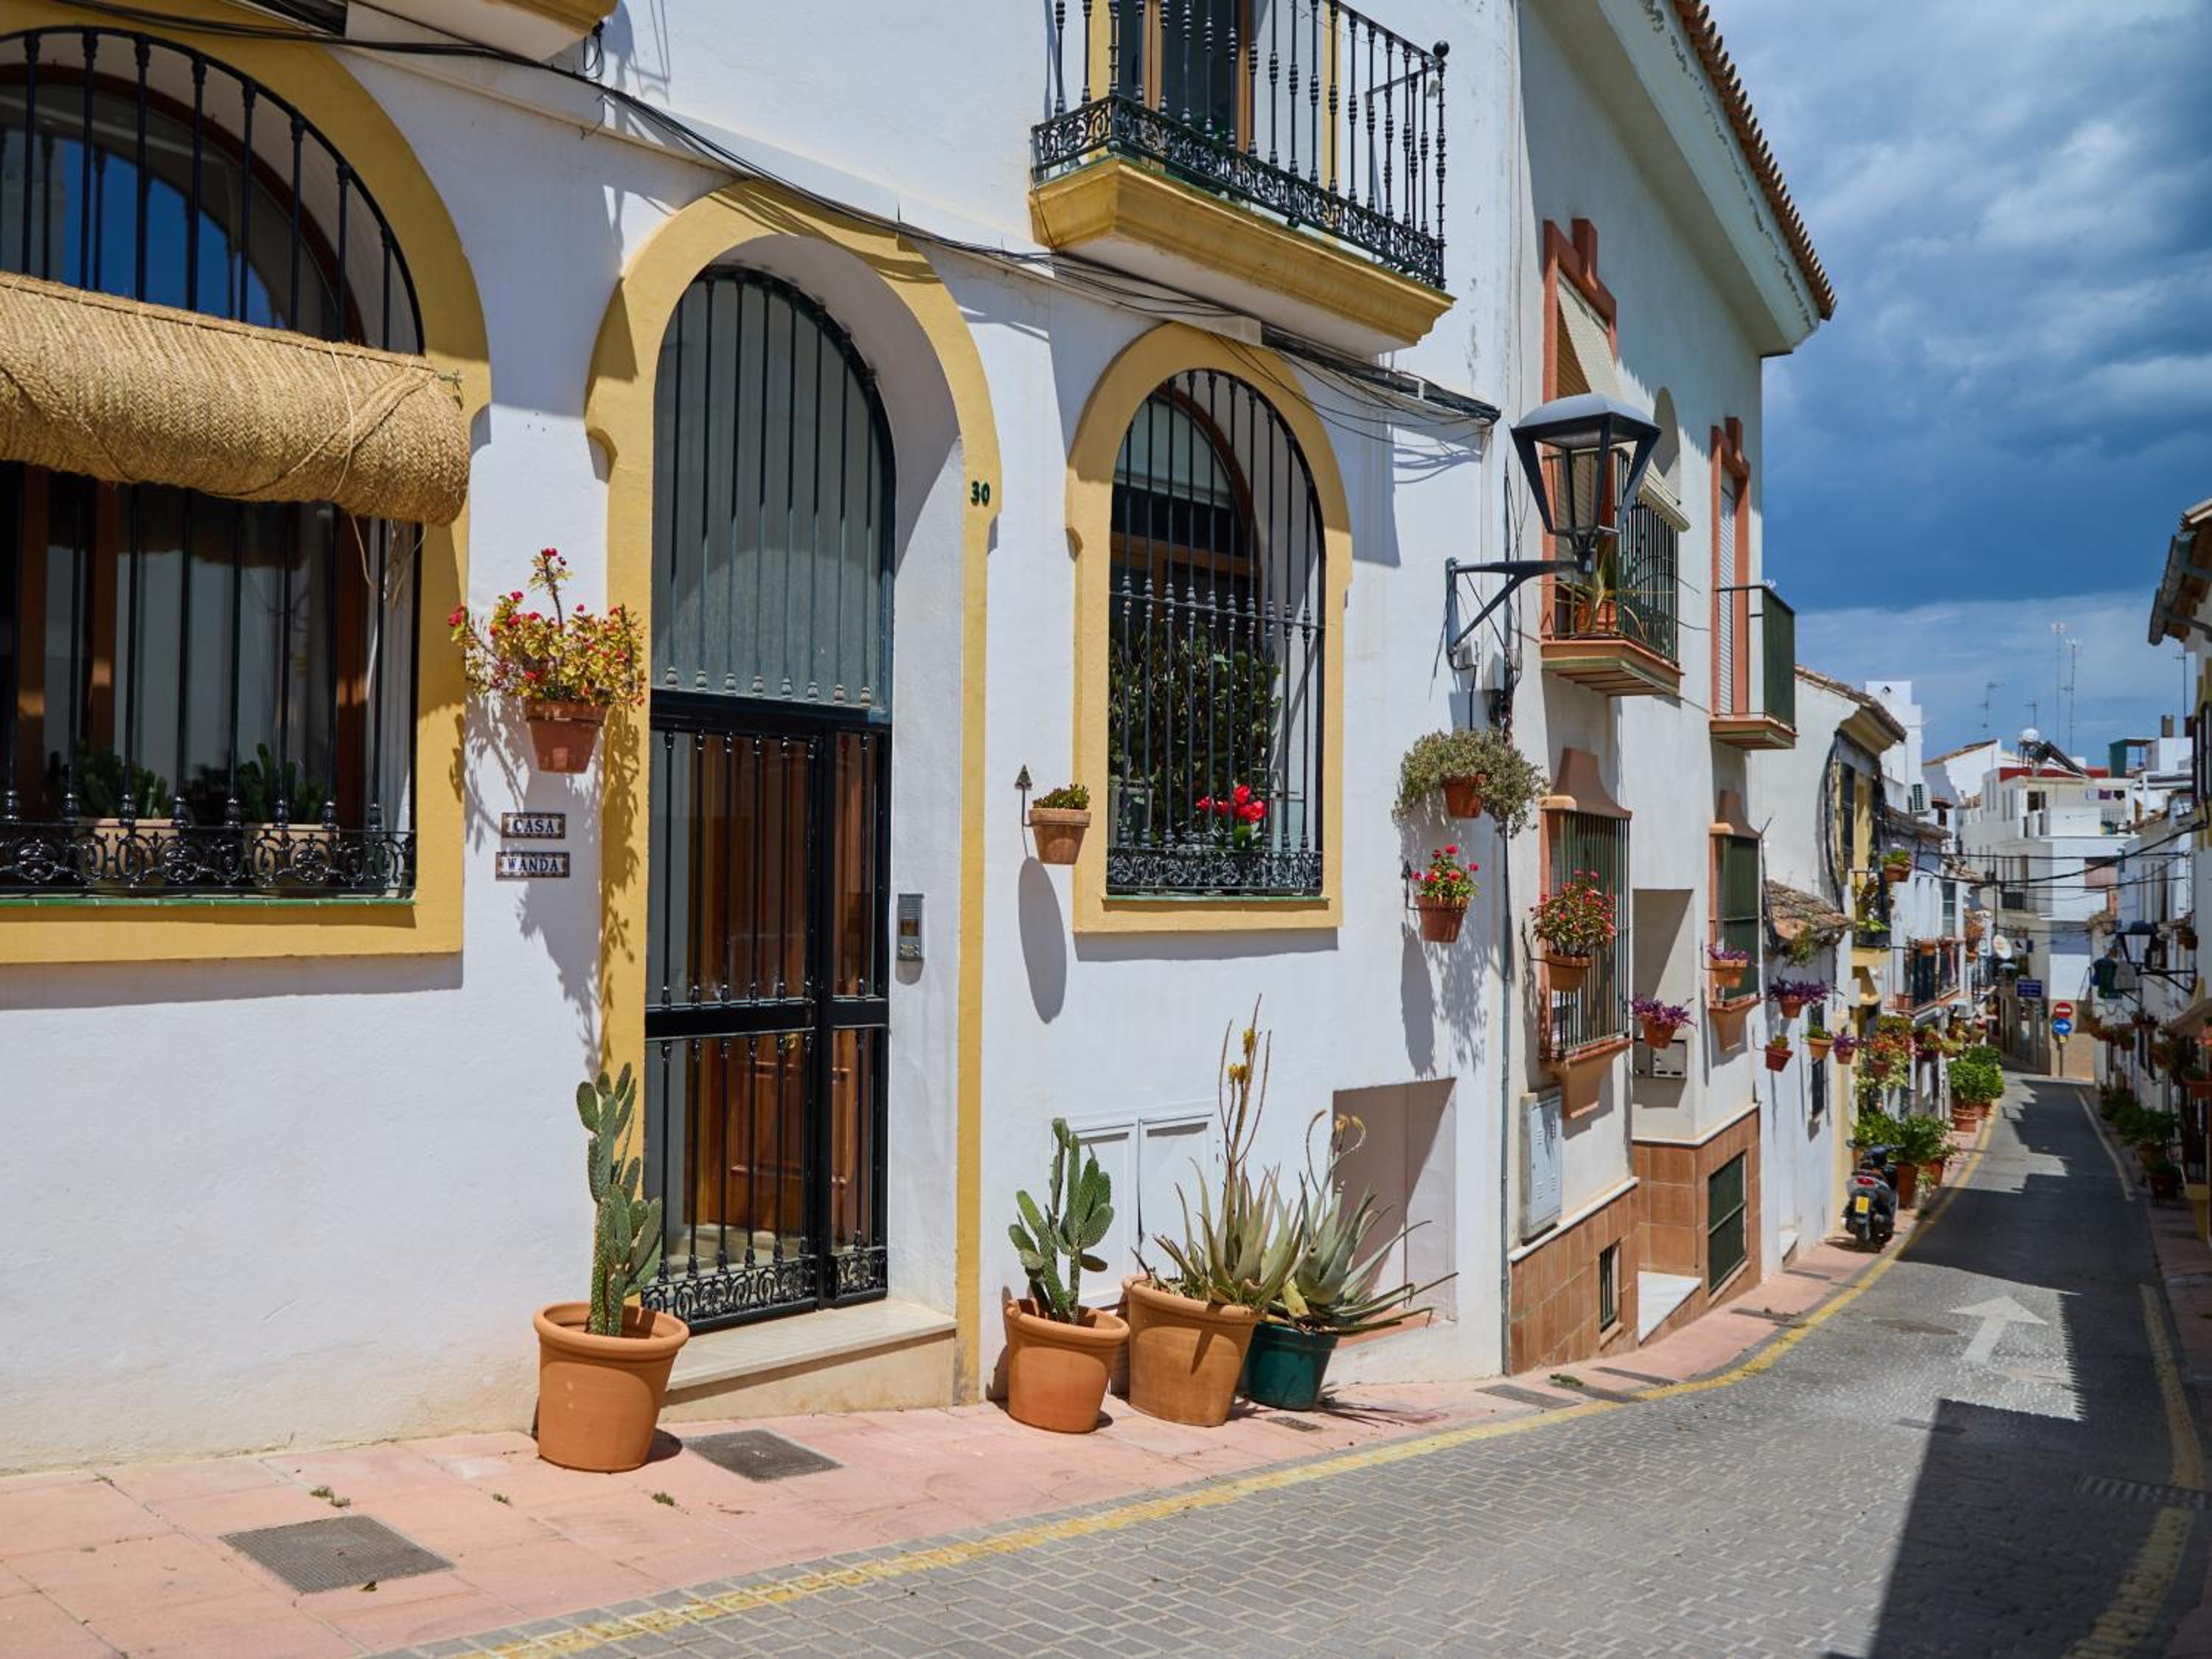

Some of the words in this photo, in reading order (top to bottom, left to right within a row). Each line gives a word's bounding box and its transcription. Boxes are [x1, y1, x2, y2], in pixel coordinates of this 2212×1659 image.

[970, 480, 990, 508] 30
[514, 819, 554, 832] CASA
[507, 858, 558, 871] WANDA
